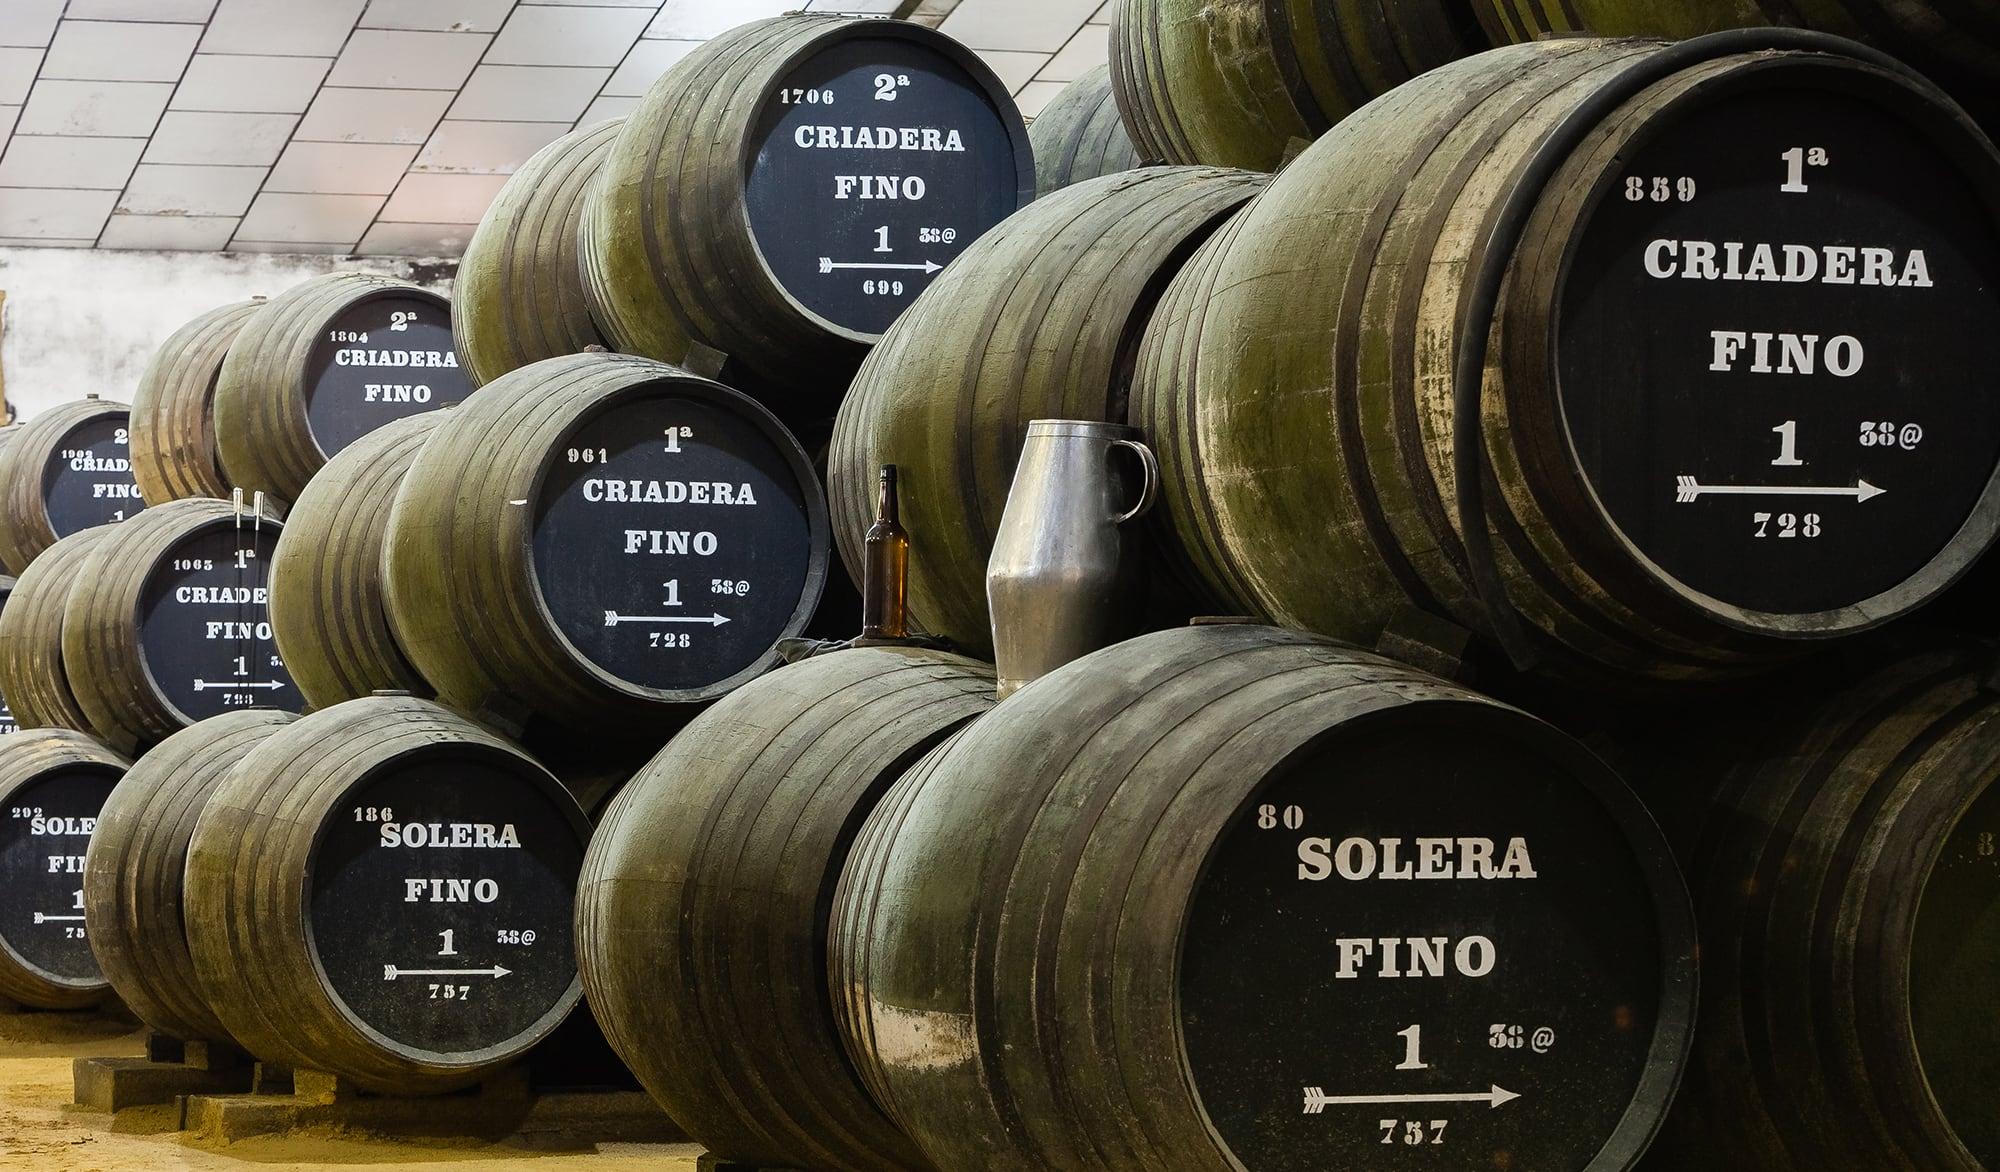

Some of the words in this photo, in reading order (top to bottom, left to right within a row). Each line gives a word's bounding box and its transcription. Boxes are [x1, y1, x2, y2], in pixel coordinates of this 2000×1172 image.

[780, 88, 835, 105] 1706
[794, 125, 966, 152] CRIADERA
[834, 175, 926, 201] FINO
[1625, 176, 1696, 203] 859
[873, 225, 893, 252] 1
[1643, 238, 1934, 288] CRIADERA
[862, 279, 904, 296] 699
[329, 330, 369, 344] 1804
[335, 349, 459, 368] CRIADERA
[1709, 330, 1864, 377] FINO
[364, 384, 432, 403] FINO
[113, 427, 129, 446] 2
[1771, 420, 1803, 466] 1
[70, 457, 134, 472] CRIAD
[567, 448, 608, 464] 961
[582, 478, 757, 505] CRIADERA
[1753, 511, 1821, 538] 728
[624, 529, 718, 556] FINO
[173, 559, 213, 571] 1065
[662, 578, 683, 606] 1
[206, 621, 273, 640] FINO
[649, 632, 691, 648] 728
[233, 655, 249, 676] 1
[12, 807, 43, 819] 292
[353, 806, 393, 822] 186
[1257, 803, 1304, 830] 80
[31, 816, 96, 836] SOLE
[380, 822, 522, 849] SOLERA
[1297, 836, 1538, 881] SOLERA
[72, 889, 84, 910] 1
[404, 878, 499, 903] FINO
[437, 928, 458, 956] 1
[1335, 935, 1496, 979] FINO
[428, 983, 470, 1001] 757
[1395, 1024, 1429, 1070] 1
[1379, 1119, 1449, 1146] 757
